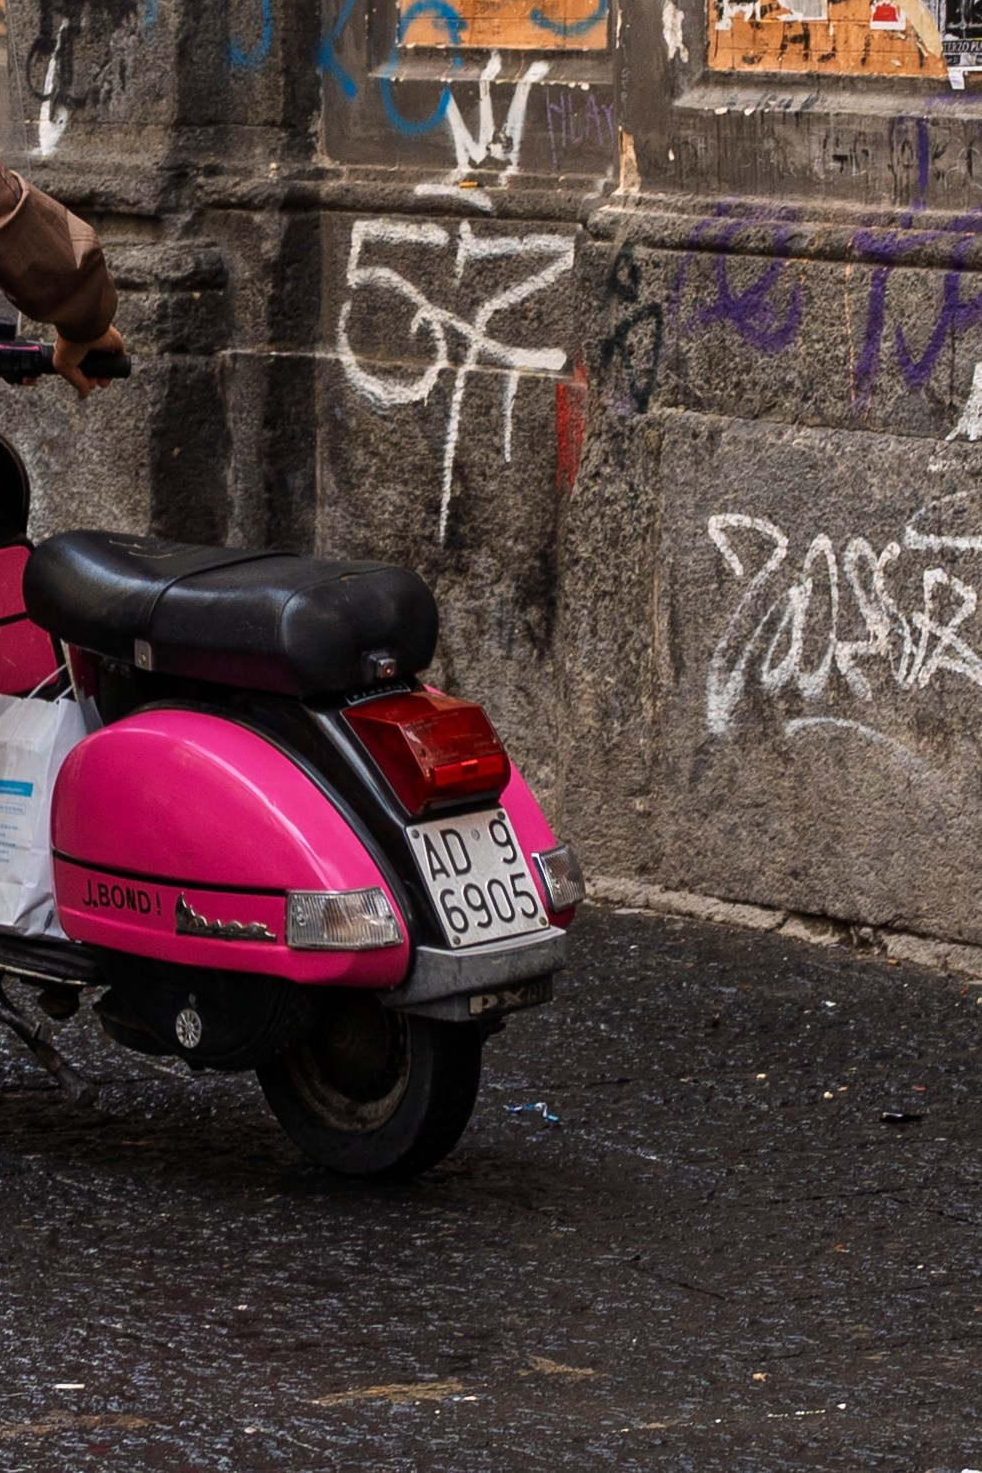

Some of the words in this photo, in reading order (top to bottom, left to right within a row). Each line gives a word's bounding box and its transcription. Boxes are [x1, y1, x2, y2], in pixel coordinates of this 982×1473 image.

[422, 828, 472, 881] AD
[488, 819, 518, 865] 9
[439, 872, 538, 933] 6905
